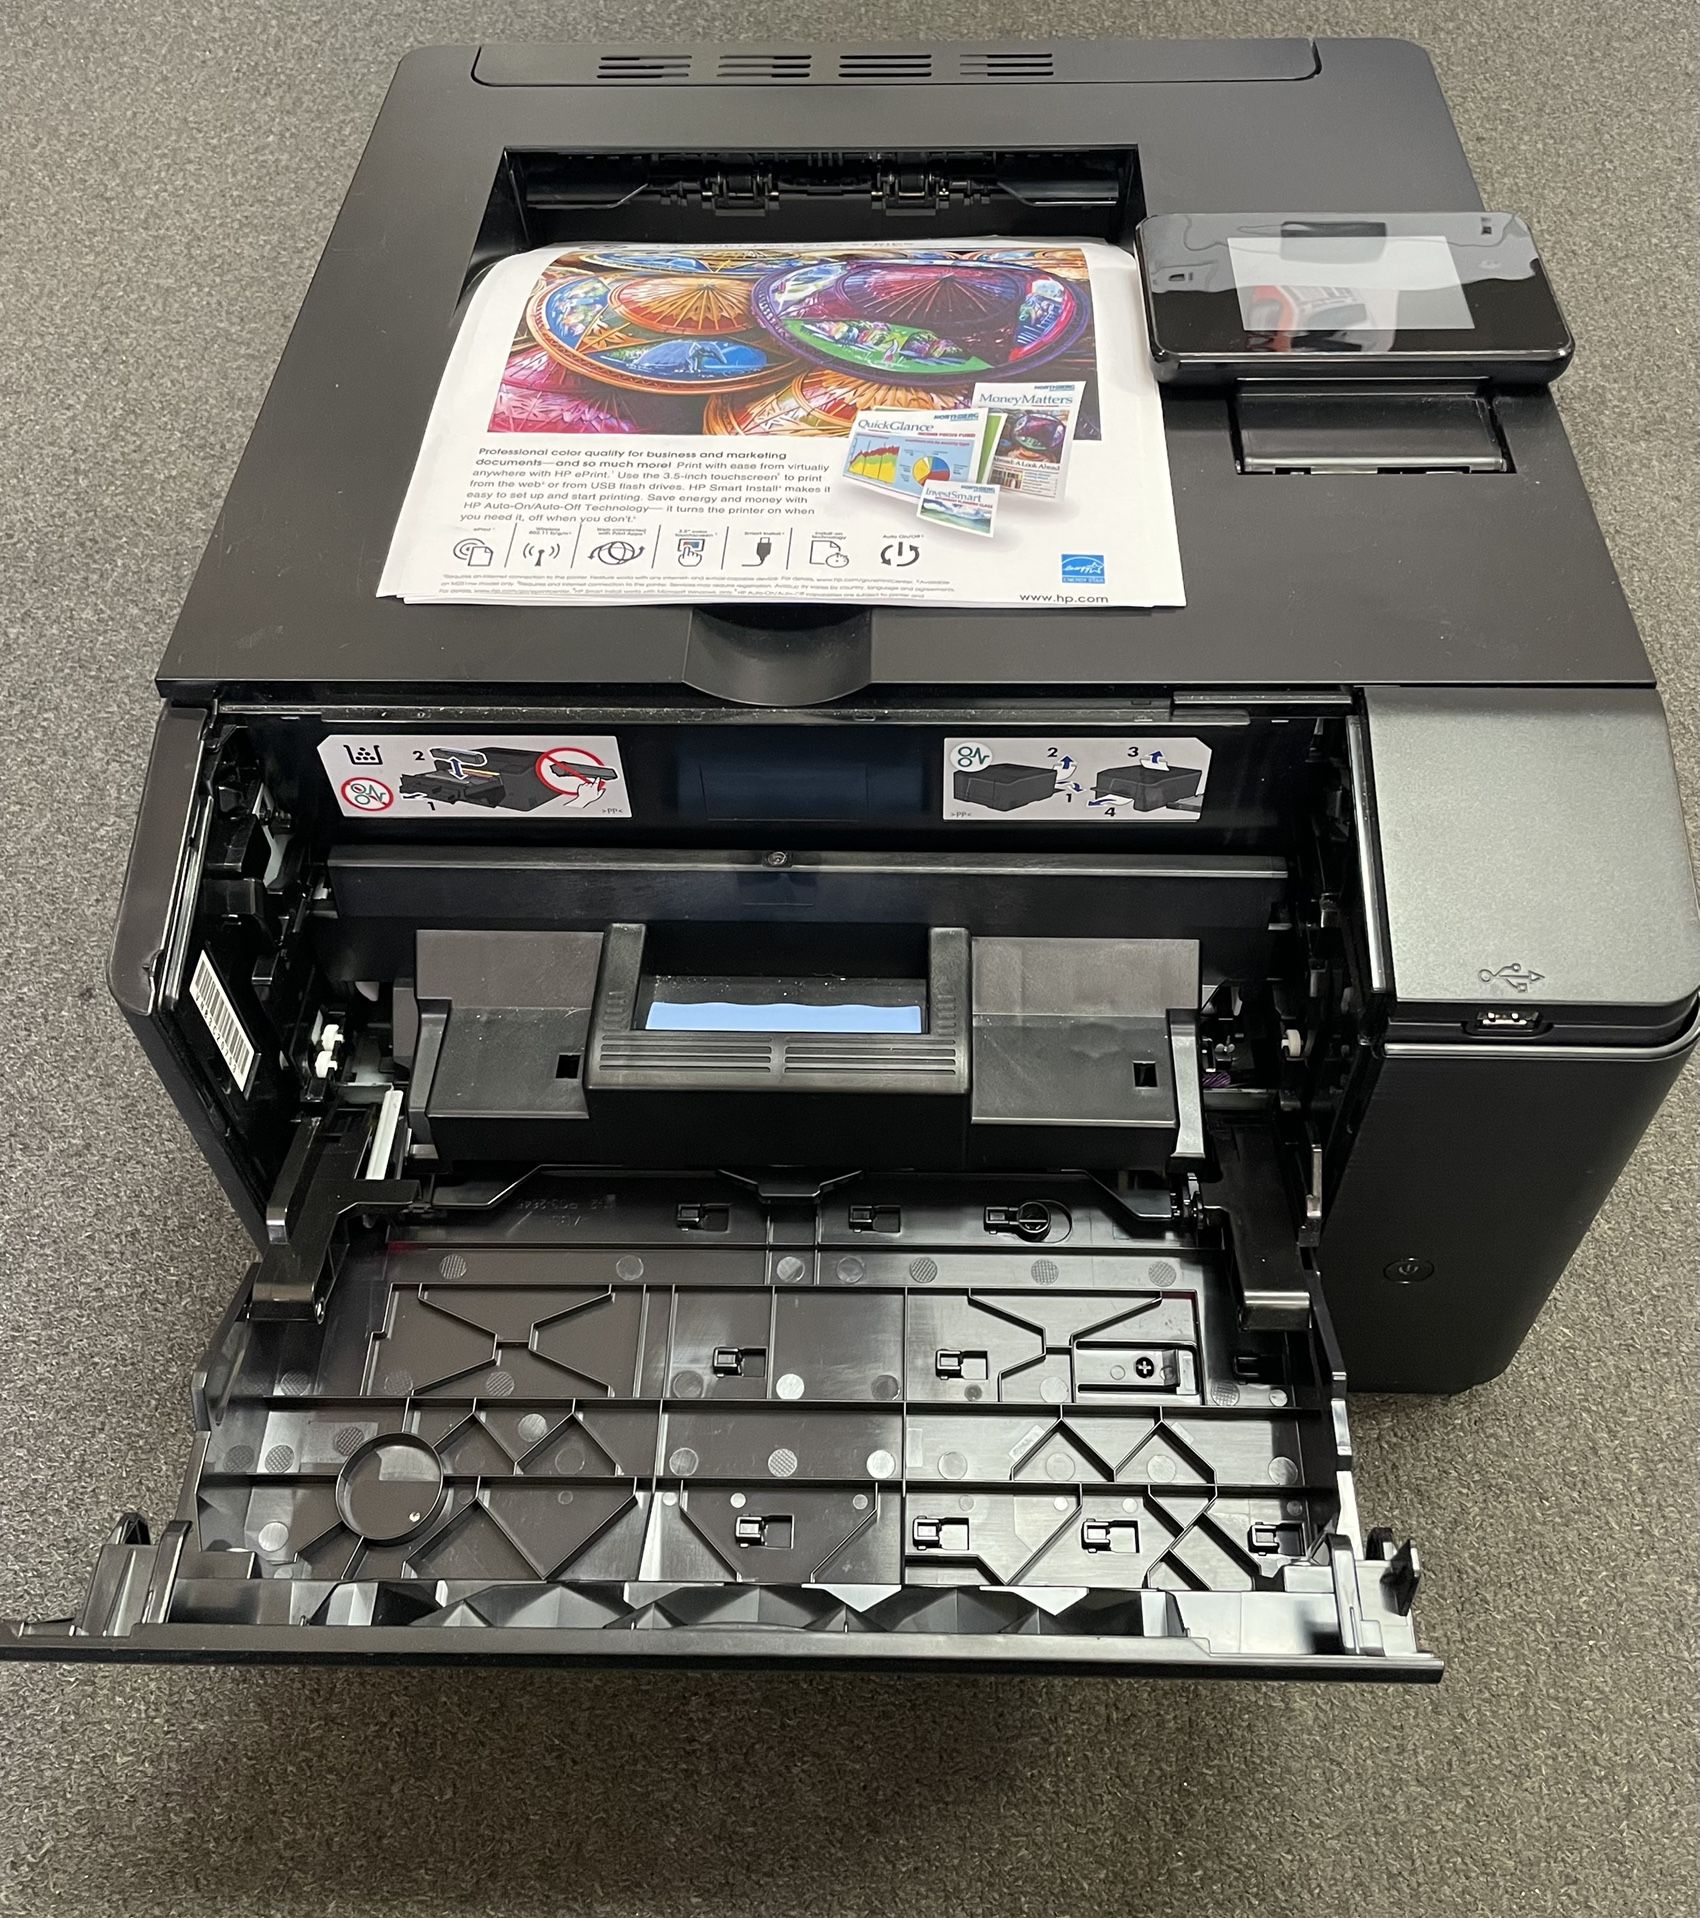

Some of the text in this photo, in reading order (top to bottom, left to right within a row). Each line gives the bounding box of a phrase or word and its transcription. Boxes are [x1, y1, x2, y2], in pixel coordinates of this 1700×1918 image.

[979, 393, 1073, 407] MoneyMatters
[858, 419, 934, 432] QuickGlance
[478, 447, 549, 456] Professional
[551, 449, 582, 457] color
[584, 449, 625, 458] quality
[646, 451, 697, 459] business
[699, 451, 724, 459] and
[726, 451, 787, 461] marketing
[599, 460, 634, 468] much
[637, 461, 672, 469] more!
[676, 461, 702, 470] Print
[760, 462, 785, 470] from
[472, 470, 526, 479] anywhere
[554, 470, 572, 478] HP
[617, 471, 640, 480] Use
[642, 472, 660, 480] the
[663, 472, 707, 481] 3.5-inch
[798, 474, 823, 484] print
[469, 479, 495, 487] from
[497, 480, 515, 488] the
[562, 481, 588, 489] from
[591, 481, 616, 490] USB
[648, 483, 685, 491] drives.
[709, 483, 742, 492] Smart
[784, 485, 821, 493] makes
[466, 492, 493, 500] easy
[496, 491, 507, 499] to
[530, 493, 545, 502] up
[547, 492, 569, 500] and
[571, 493, 597, 501] start
[599, 493, 643, 503] printing.
[647, 493, 676, 502] Save
[678, 495, 718, 505] energy
[720, 495, 742, 503] and
[745, 497, 783, 505] money
[926, 488, 981, 502] InvestSmart
[484, 502, 582, 511] Auto-On/Auto-Off
[666, 505, 673, 513] it
[676, 505, 705, 514] turns
[707, 506, 725, 514] the
[728, 507, 764, 515] printer
[784, 507, 815, 515] when
[460, 514, 481, 522] you
[483, 513, 513, 521] need
[528, 514, 544, 522] off
[546, 514, 577, 522] when
[579, 516, 601, 524] you
[1020, 594, 1109, 604] www.hp.com
[413, 750, 425, 761] 2
[1047, 747, 1058, 757] 2
[1127, 746, 1139, 757] 3
[1066, 793, 1073, 803] 1
[428, 801, 435, 811] 1
[1104, 807, 1116, 817] 4
